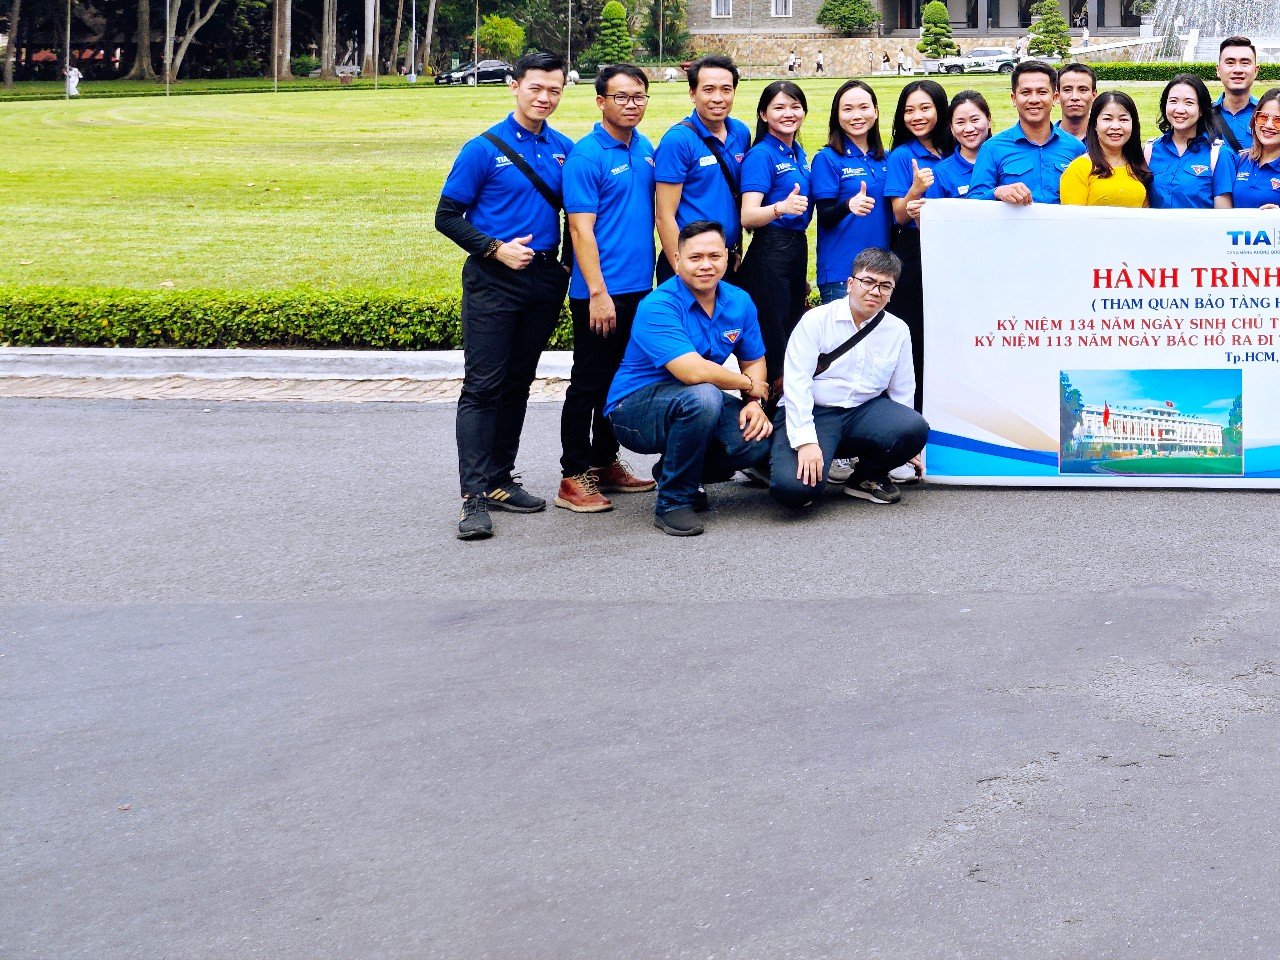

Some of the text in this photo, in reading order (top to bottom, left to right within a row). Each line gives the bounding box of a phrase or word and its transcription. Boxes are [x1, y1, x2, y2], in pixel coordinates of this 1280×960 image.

[1226, 230, 1272, 246] TIA
[1092, 262, 1179, 288] HÀNH
[1101, 298, 1143, 309] THAM
[1148, 298, 1189, 311] QUAN
[1194, 294, 1225, 309] BẢO
[1230, 293, 1270, 309] TÀNG
[997, 316, 1019, 331] KỶ
[1025, 317, 1063, 334] NIỆM
[1070, 319, 1095, 330] 134
[1101, 316, 1136, 330] NĂM
[1141, 315, 1184, 330] NGÀY
[1190, 318, 1226, 330] SINH
[1232, 314, 1264, 330] CHỦ
[975, 332, 995, 347] KỶ
[1002, 333, 1040, 349] NIỆM
[1047, 335, 1073, 347] 113
[1078, 332, 1113, 347] NĂM
[1118, 331, 1161, 347] NGÀY
[1166, 332, 1198, 346] BÁC
[1204, 329, 1226, 346] HỒ
[1231, 335, 1252, 346] RA
[1258, 335, 1274, 346] ĐI
[1225, 352, 1279, 365] Tp.HCM,
